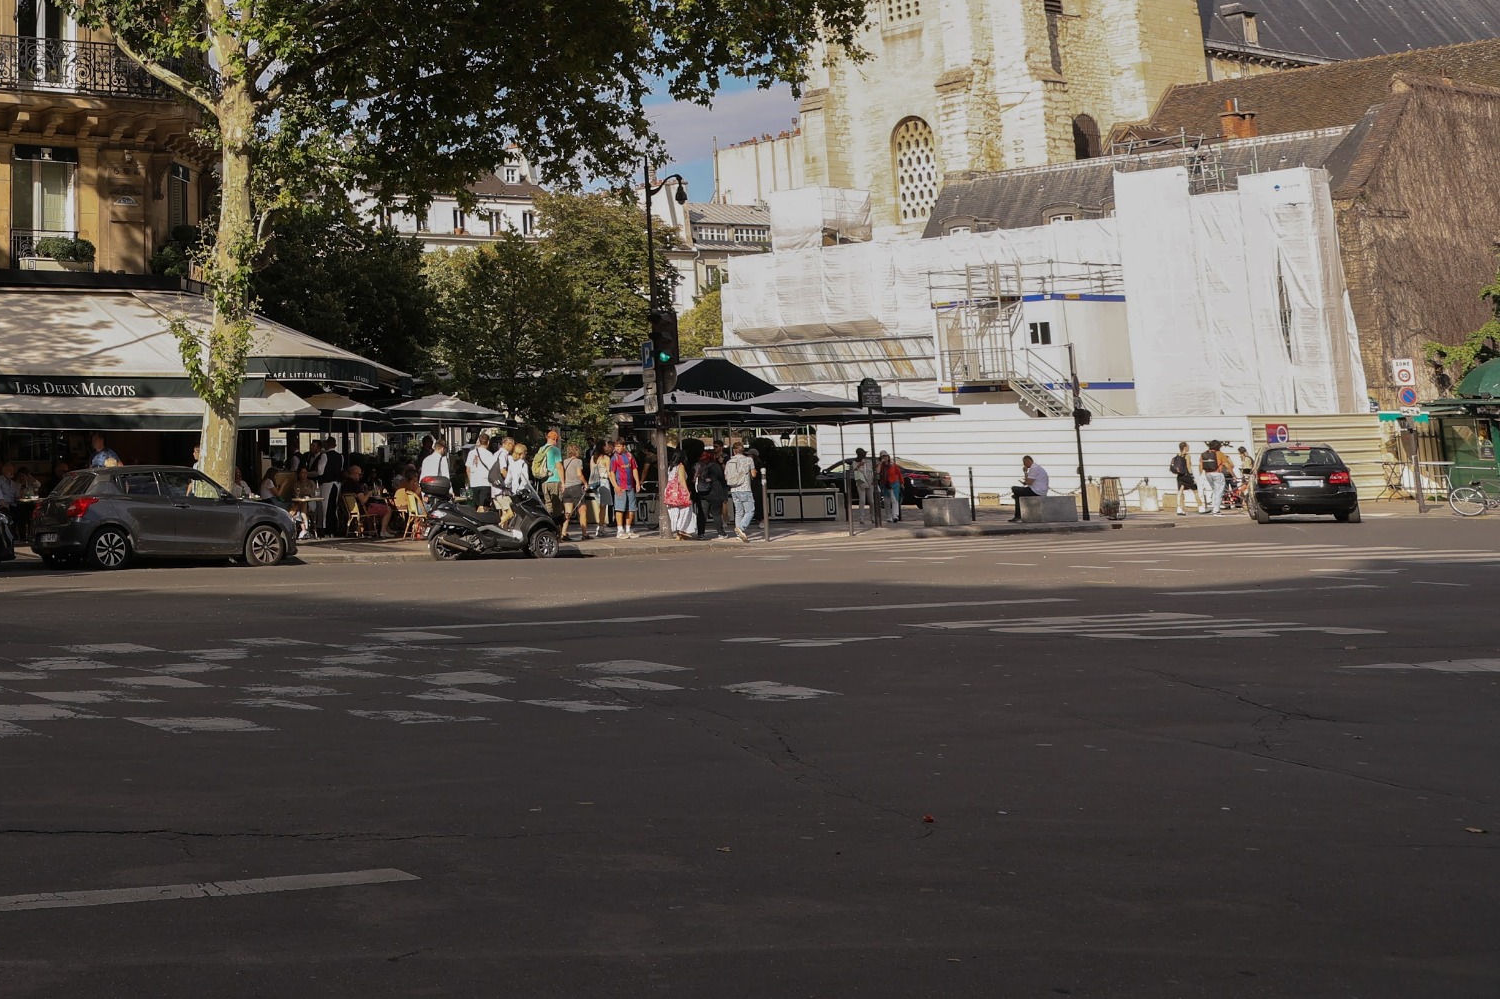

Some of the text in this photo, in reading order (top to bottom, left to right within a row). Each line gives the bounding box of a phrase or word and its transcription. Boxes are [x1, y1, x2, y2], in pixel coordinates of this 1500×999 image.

[644, 346, 650, 364] P
[15, 382, 136, 396] LES DEUX MAGOTS
[722, 390, 755, 400] MAGOTS
